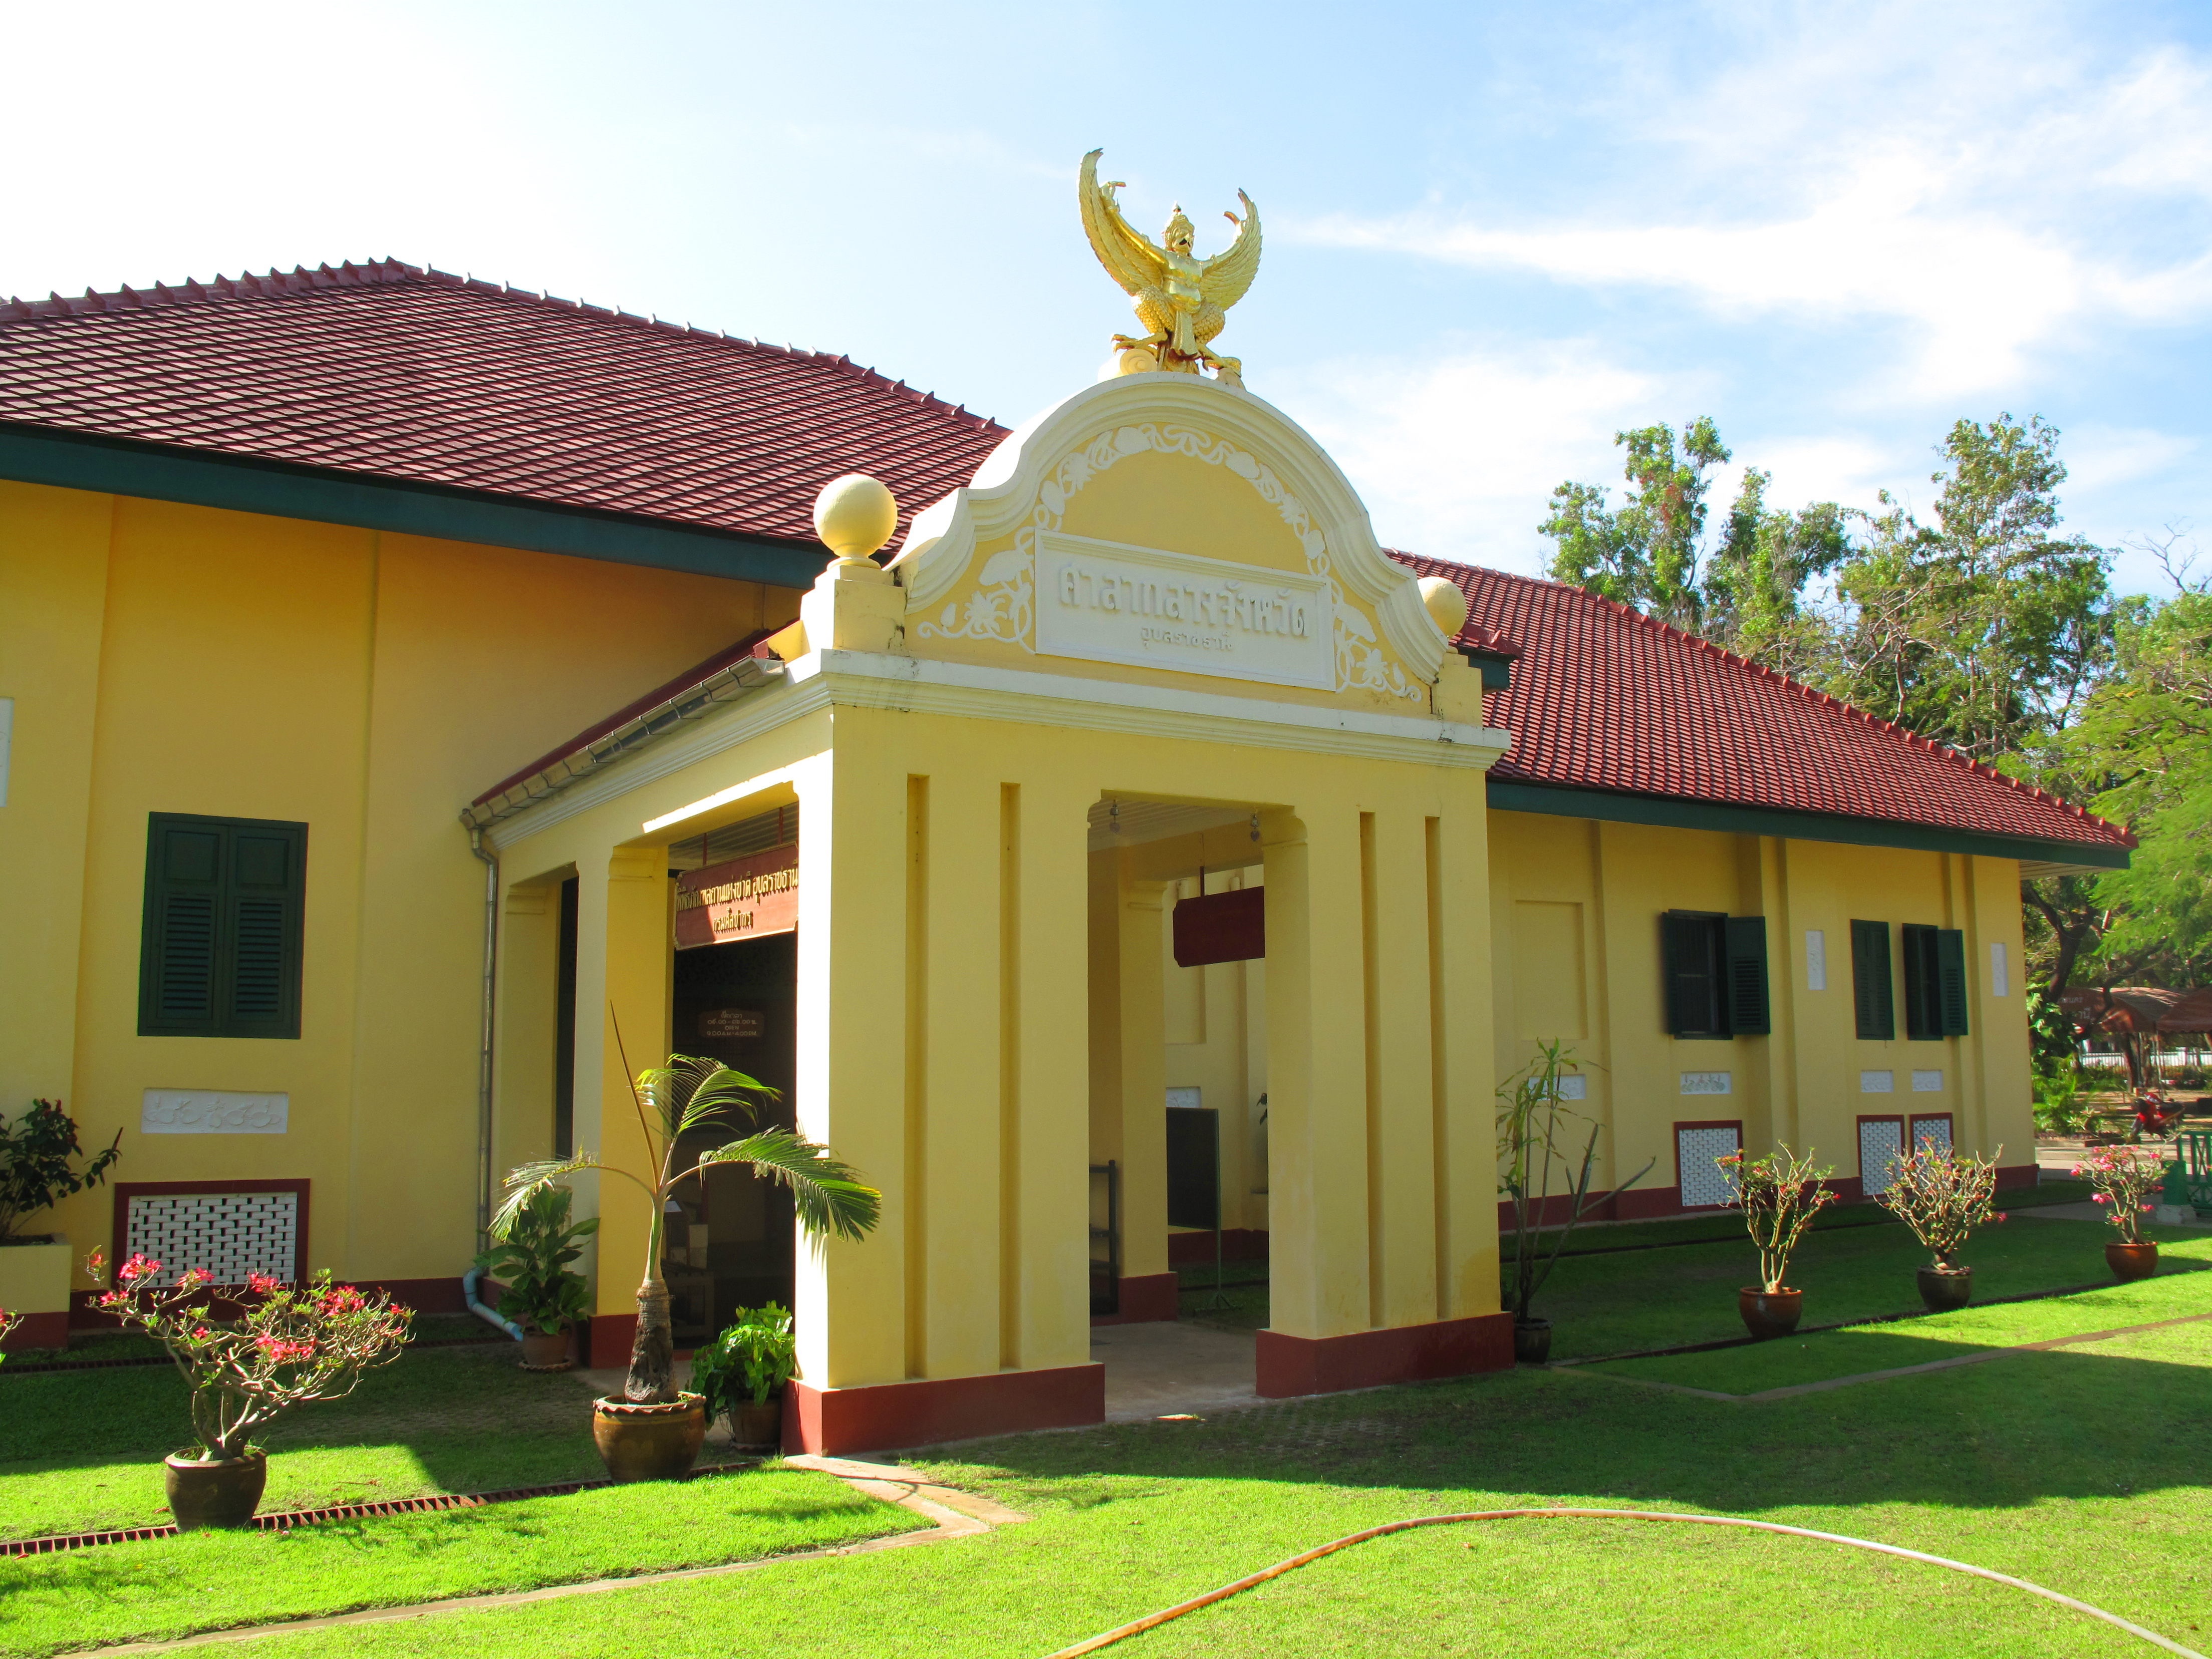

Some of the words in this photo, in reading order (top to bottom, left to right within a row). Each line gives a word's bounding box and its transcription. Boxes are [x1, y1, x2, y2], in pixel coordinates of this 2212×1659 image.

[1058, 562, 1309, 637] ศาลากลางจังหวัด
[1141, 627, 1233, 651] อุบลราชธานี
[676, 871, 751, 911] พิพิธภัณฑสถานแห่งชาติ
[753, 858, 798, 903] อุบลราชธานี
[713, 907, 752, 932] กรมศิลปากร
